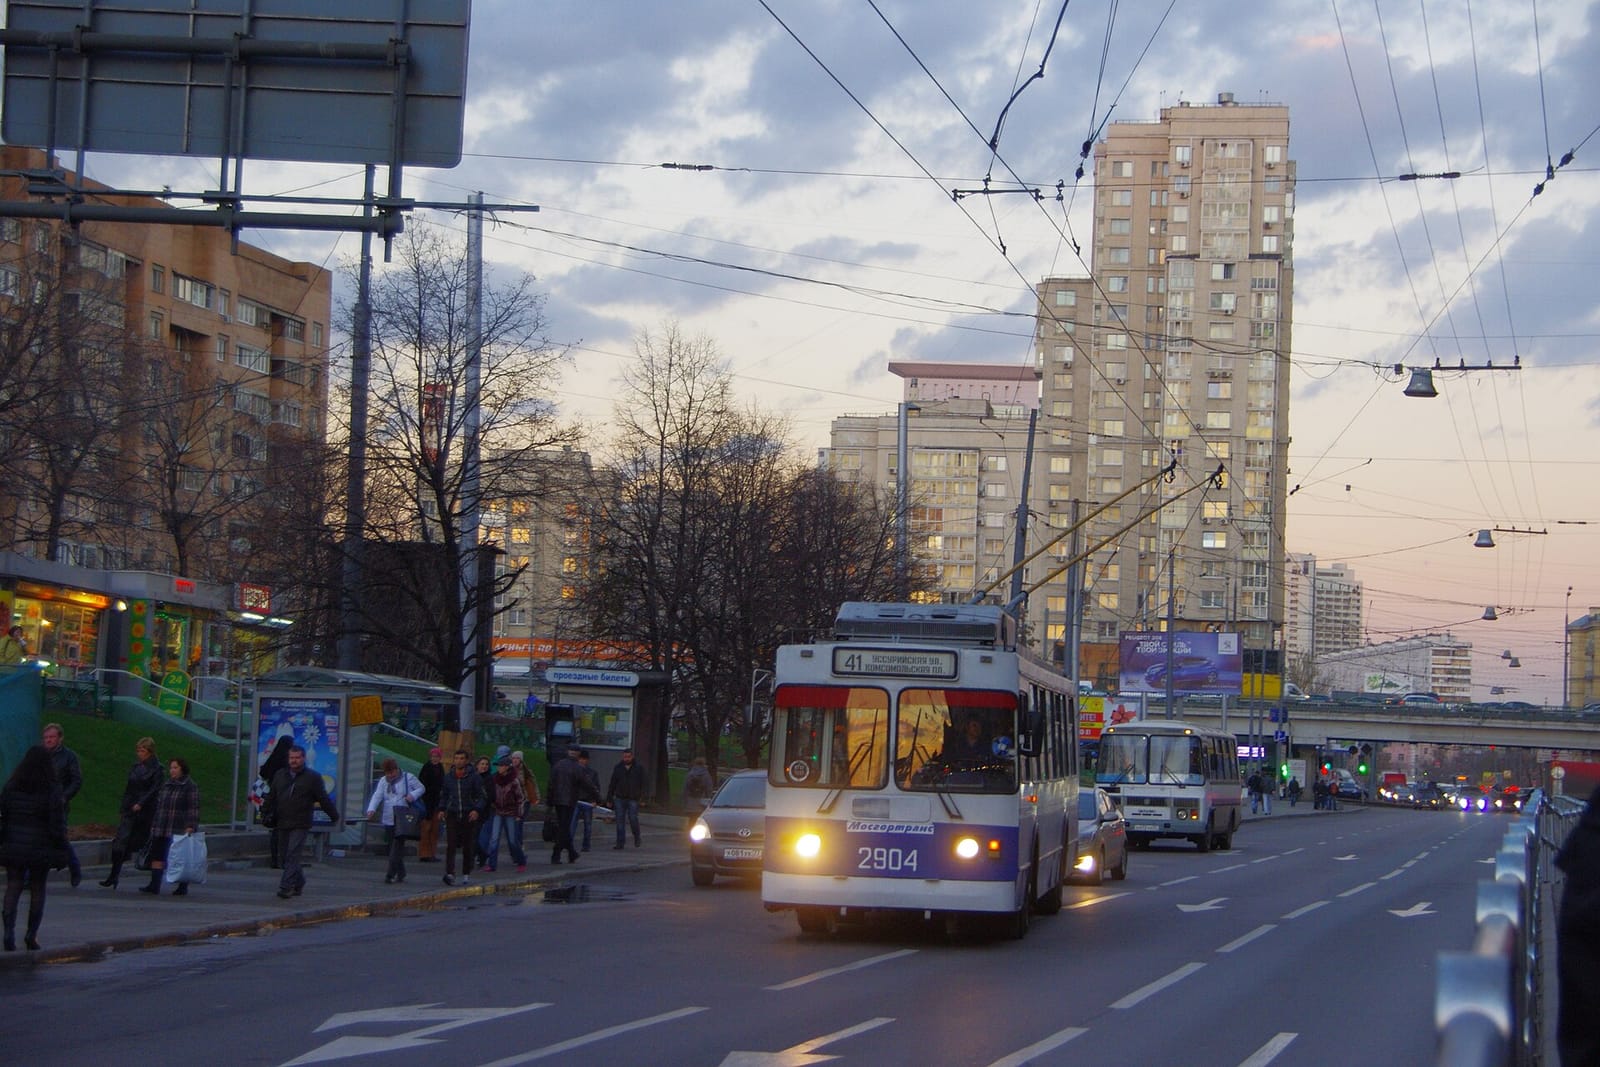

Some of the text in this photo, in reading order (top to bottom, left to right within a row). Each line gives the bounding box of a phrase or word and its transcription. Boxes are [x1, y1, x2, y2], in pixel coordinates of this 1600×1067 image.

[844, 654, 863, 671] 41
[872, 655, 928, 665] УССУРИЙСКАЯ
[865, 665, 930, 673] КОМСОМОЛЬСКАЯ
[553, 671, 632, 683] проездные билеты
[848, 822, 934, 833] Мосгортранс
[858, 847, 918, 872] 2904
